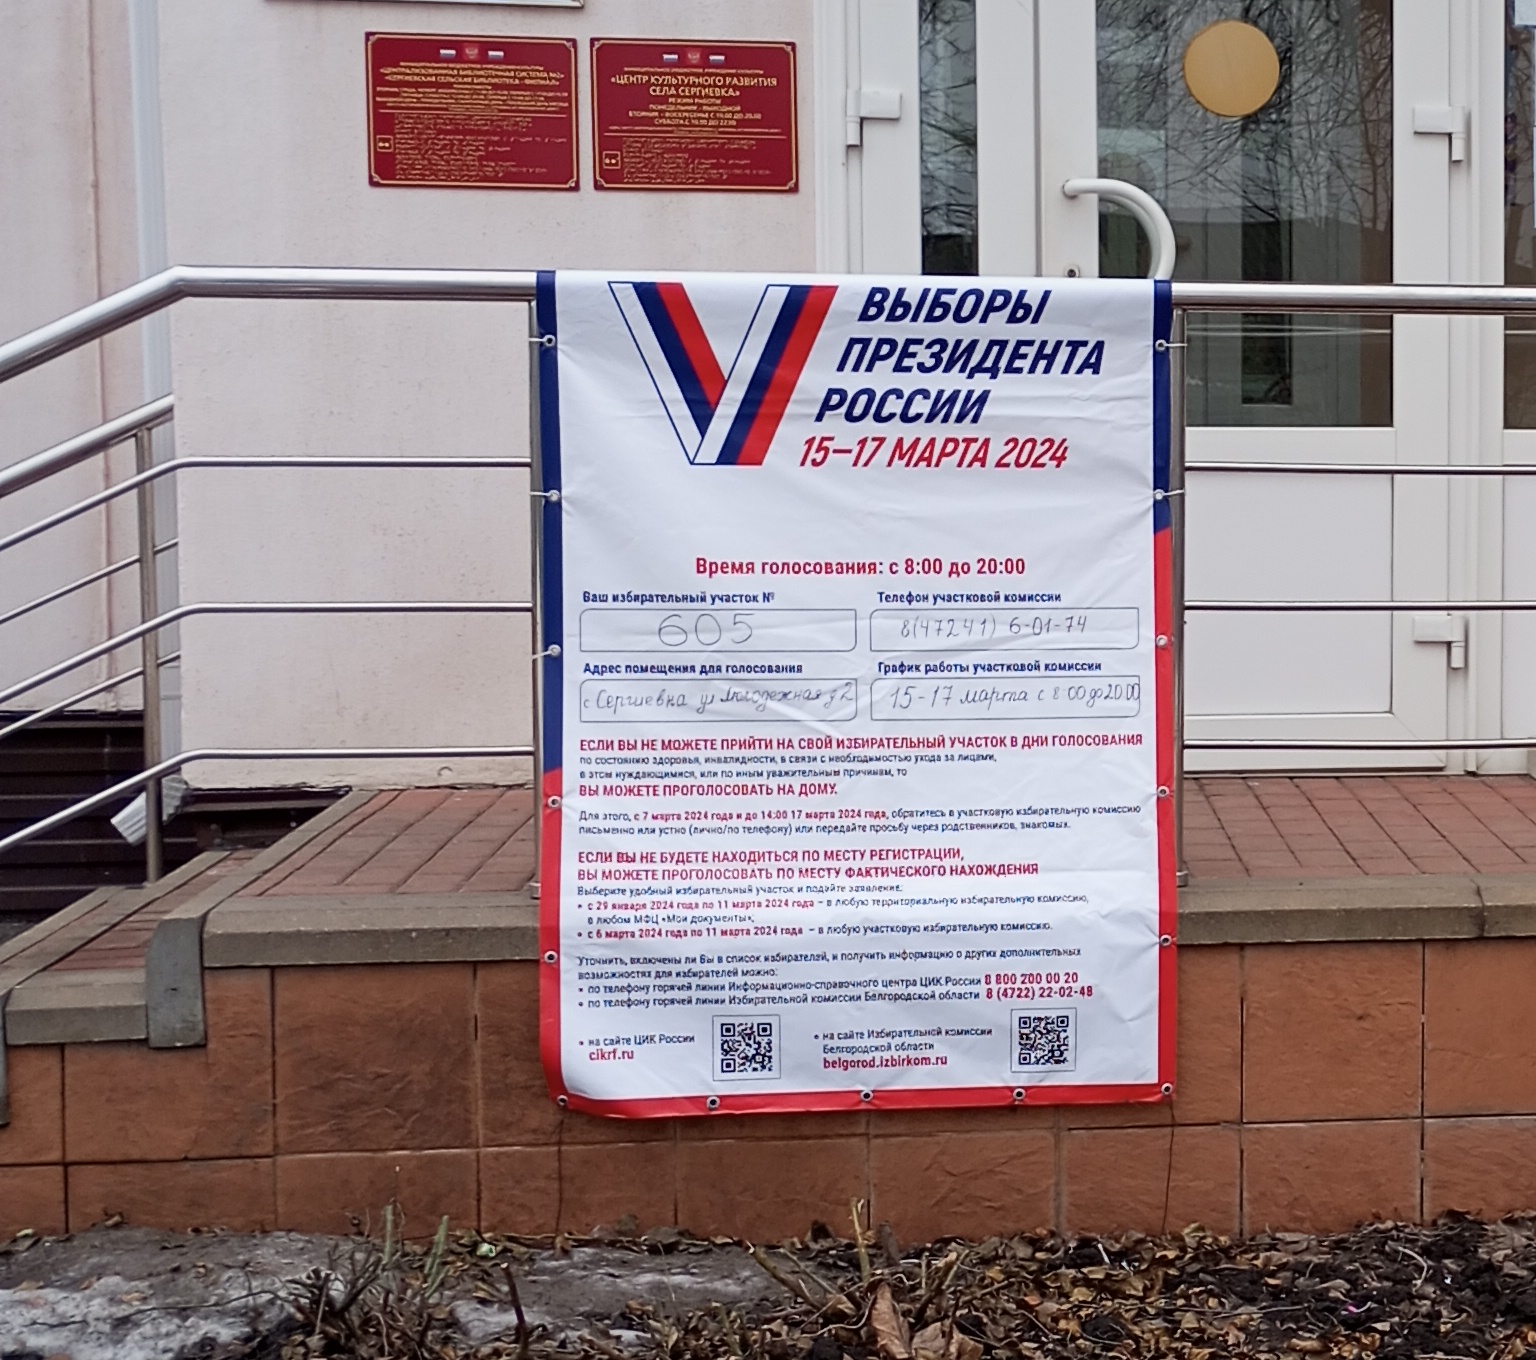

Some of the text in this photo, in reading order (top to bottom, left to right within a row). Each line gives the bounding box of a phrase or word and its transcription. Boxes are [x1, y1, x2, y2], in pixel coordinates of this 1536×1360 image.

[611, 75, 777, 86] «ЦЕНТР КУЛЬТУРНОГО РАЗВИТИЯ
[650, 86, 740, 96] СЕЛА СЕРГИЕВКА»
[858, 288, 1052, 325] ВЫБОРЫ
[838, 338, 1105, 379] ПРЕЗИДЕНТА
[815, 388, 989, 424] РОССИИ
[888, 438, 992, 469] МАРТА
[995, 438, 1069, 469] 2024
[696, 558, 1025, 578] Время голосования: с 8:00 до 20:00
[583, 591, 774, 605] Ваш избирательный участок №
[878, 591, 1061, 604] Телефон участковой комиссии
[658, 613, 754, 646] 605
[584, 663, 802, 676] Адрес помещения для голосования
[878, 660, 1101, 674] График работы участковой комиссии
[960, 688, 1028, 711] марта
[580, 734, 1143, 751] ЕСЛИ ВЫ НЕ МОЖЕТЕ ПРИЙТИ НА СВОЙ ИЗБИРАТЕЛЬНЫЙ УЧАСТОК В ДНИ ГОЛОСОВАНИЯ
[579, 783, 837, 797] ВЫ МОЖЕТЕ ПРОГОЛОСОВАТЬ НА ДОМУ.
[578, 848, 964, 865] ЕСЛИ ВЫ НЕ БУДЕТЕ НАХОДИТЬСЯ ПО МЕСТУ РЕГИСТРАЦИИ,
[578, 864, 1038, 880] ВЫ МОЖЕТЕ ПРОГОЛОСОВАТЬ ПО МЕСТУ ФАКТИЧЕСКОГО НАХОЖДЕНИЯ
[984, 973, 1078, 985] 8 800 200 00 20
[986, 986, 1093, 1001] 8 (4722) 22-02-48
[589, 1034, 695, 1046] на сайте ЦИК России
[589, 1048, 634, 1061] cikrf.ru
[823, 1054, 948, 1070] belgorod.izbirkom.ru
